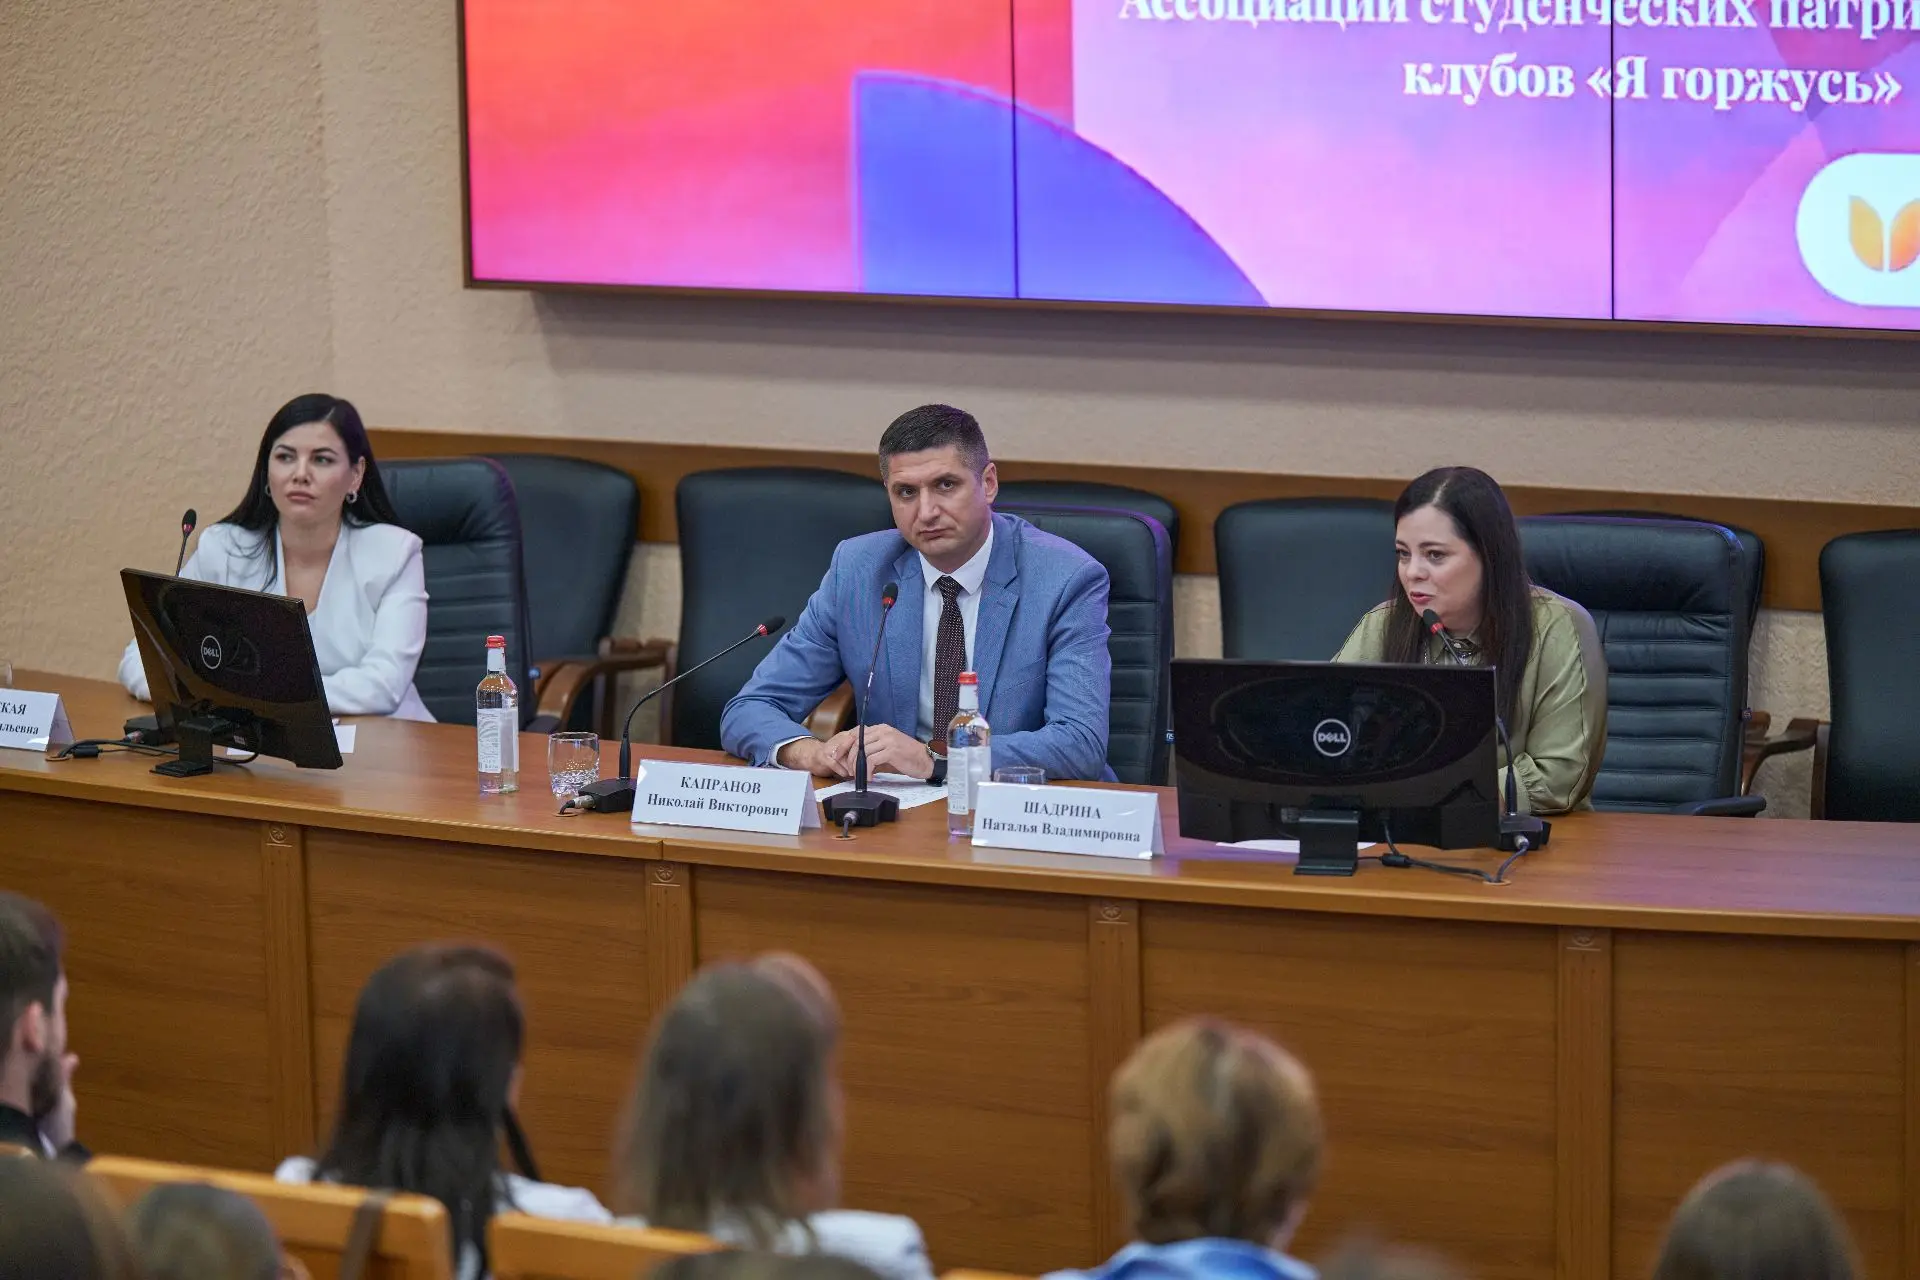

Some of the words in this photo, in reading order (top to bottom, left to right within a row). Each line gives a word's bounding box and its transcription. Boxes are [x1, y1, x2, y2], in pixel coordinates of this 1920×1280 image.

[1420, 0, 1758, 34] студенческих
[1402, 52, 1575, 106] клубов
[1586, 55, 1649, 100] «Я
[1661, 65, 1902, 112] горжусь»
[203, 646, 220, 658] DELL
[0, 701, 27, 715] КАЯ
[1317, 732, 1347, 743] DELL
[681, 776, 762, 794] КАПРАНОВ
[647, 793, 705, 809] Николай
[708, 798, 788, 817] Викторович
[1024, 801, 1101, 819] ШАДРИНА
[982, 818, 1038, 834] Наталья
[1042, 823, 1141, 842] Владимировна
